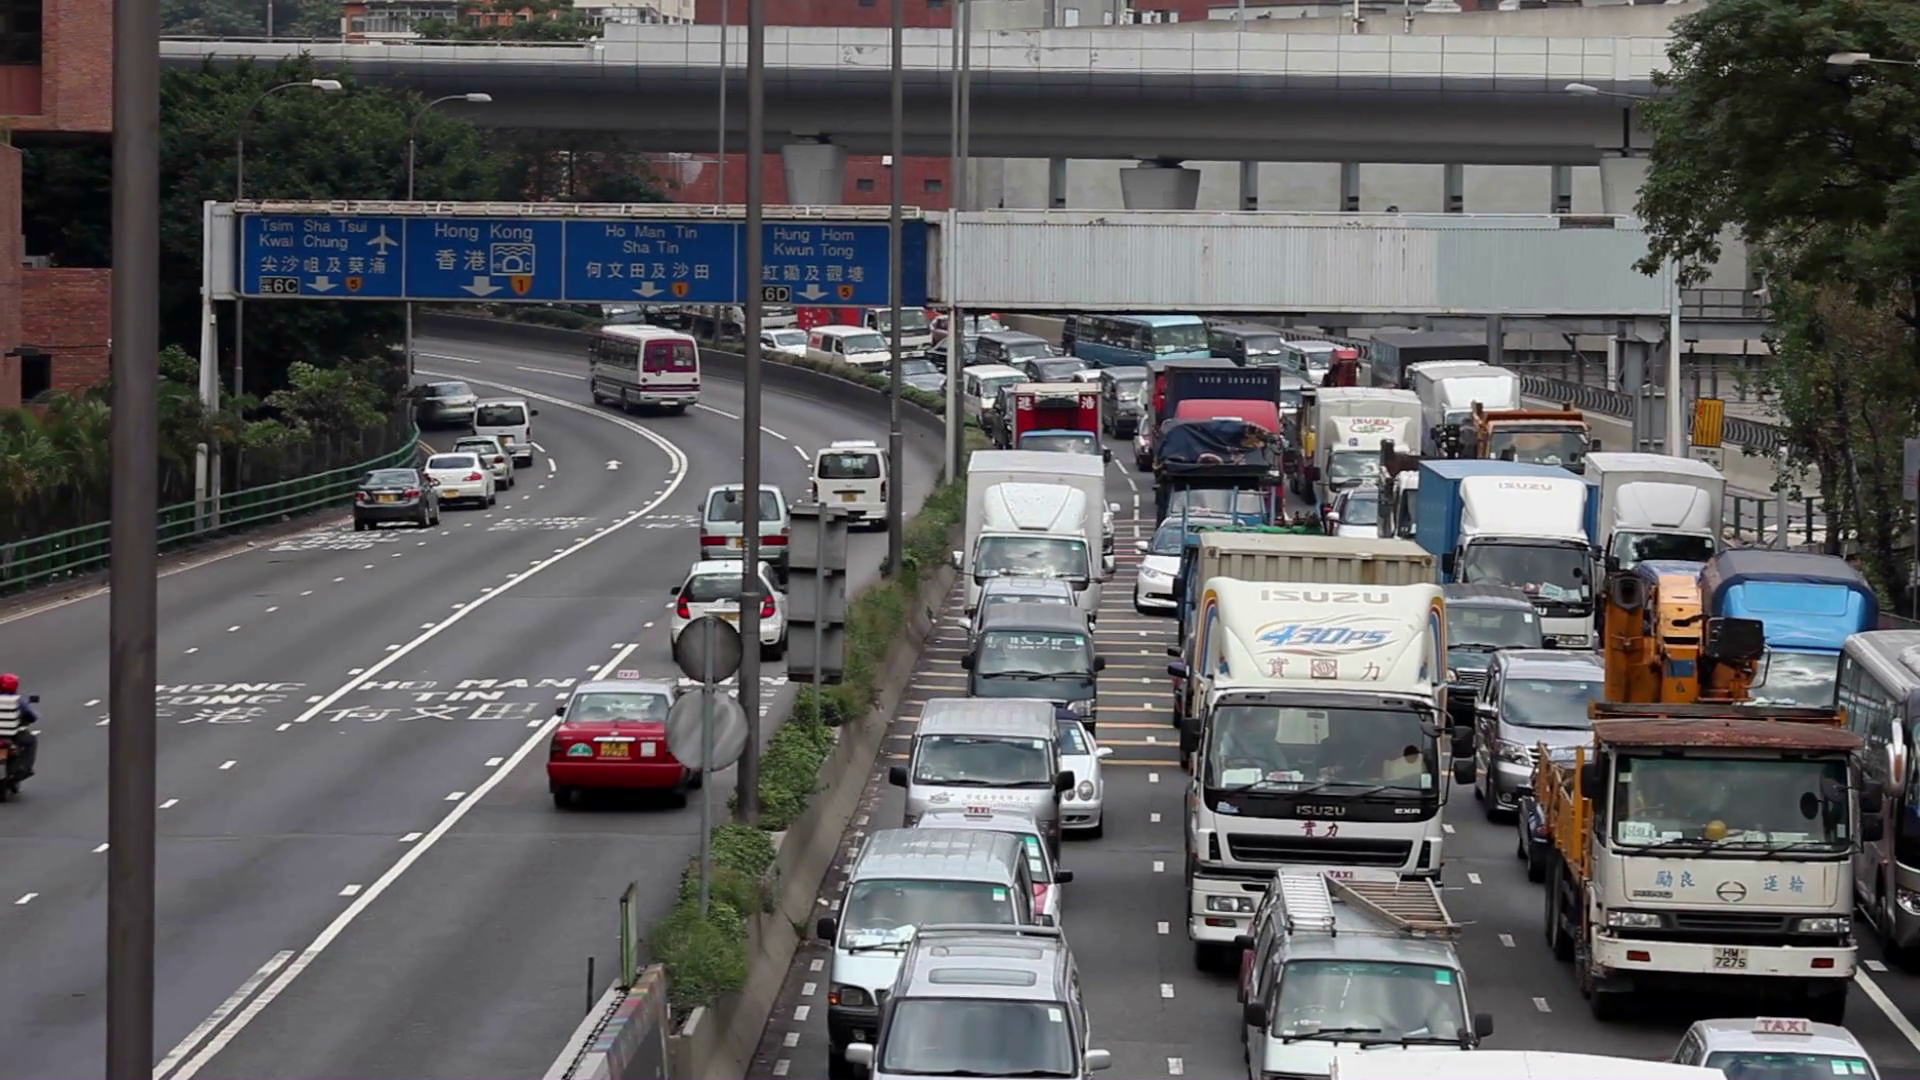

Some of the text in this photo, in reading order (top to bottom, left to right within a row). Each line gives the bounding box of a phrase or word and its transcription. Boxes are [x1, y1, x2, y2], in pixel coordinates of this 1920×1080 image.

[261, 219, 368, 233] Tsim Sha Tsui
[434, 222, 534, 243] Hong Kong
[605, 224, 698, 239] Ho Man Tin
[774, 227, 855, 243] Hung Hom
[259, 234, 349, 251] Kwai Chung
[622, 240, 679, 254] Sha Tin
[773, 243, 854, 260] Kwun Tong
[260, 255, 386, 274] 尖沙咀及葵涌
[435, 249, 487, 271] 香港
[586, 261, 710, 280] 何文田及沙田
[273, 279, 298, 293] 6C
[350, 279, 358, 290] 5
[518, 279, 524, 292] 1
[765, 287, 789, 302] 6D
[841, 287, 850, 298] 5
[1498, 482, 1552, 491] ISUZU
[1261, 590, 1389, 604] ISUZU
[155, 683, 307, 693] HONG
[357, 678, 577, 690] HO MAN
[412, 691, 505, 701] TIN
[323, 702, 539, 722] 何文田
[1296, 806, 1346, 815] ISUZU
[1716, 958, 1746, 967] 7275
[1762, 1020, 1806, 1032] TAXI
